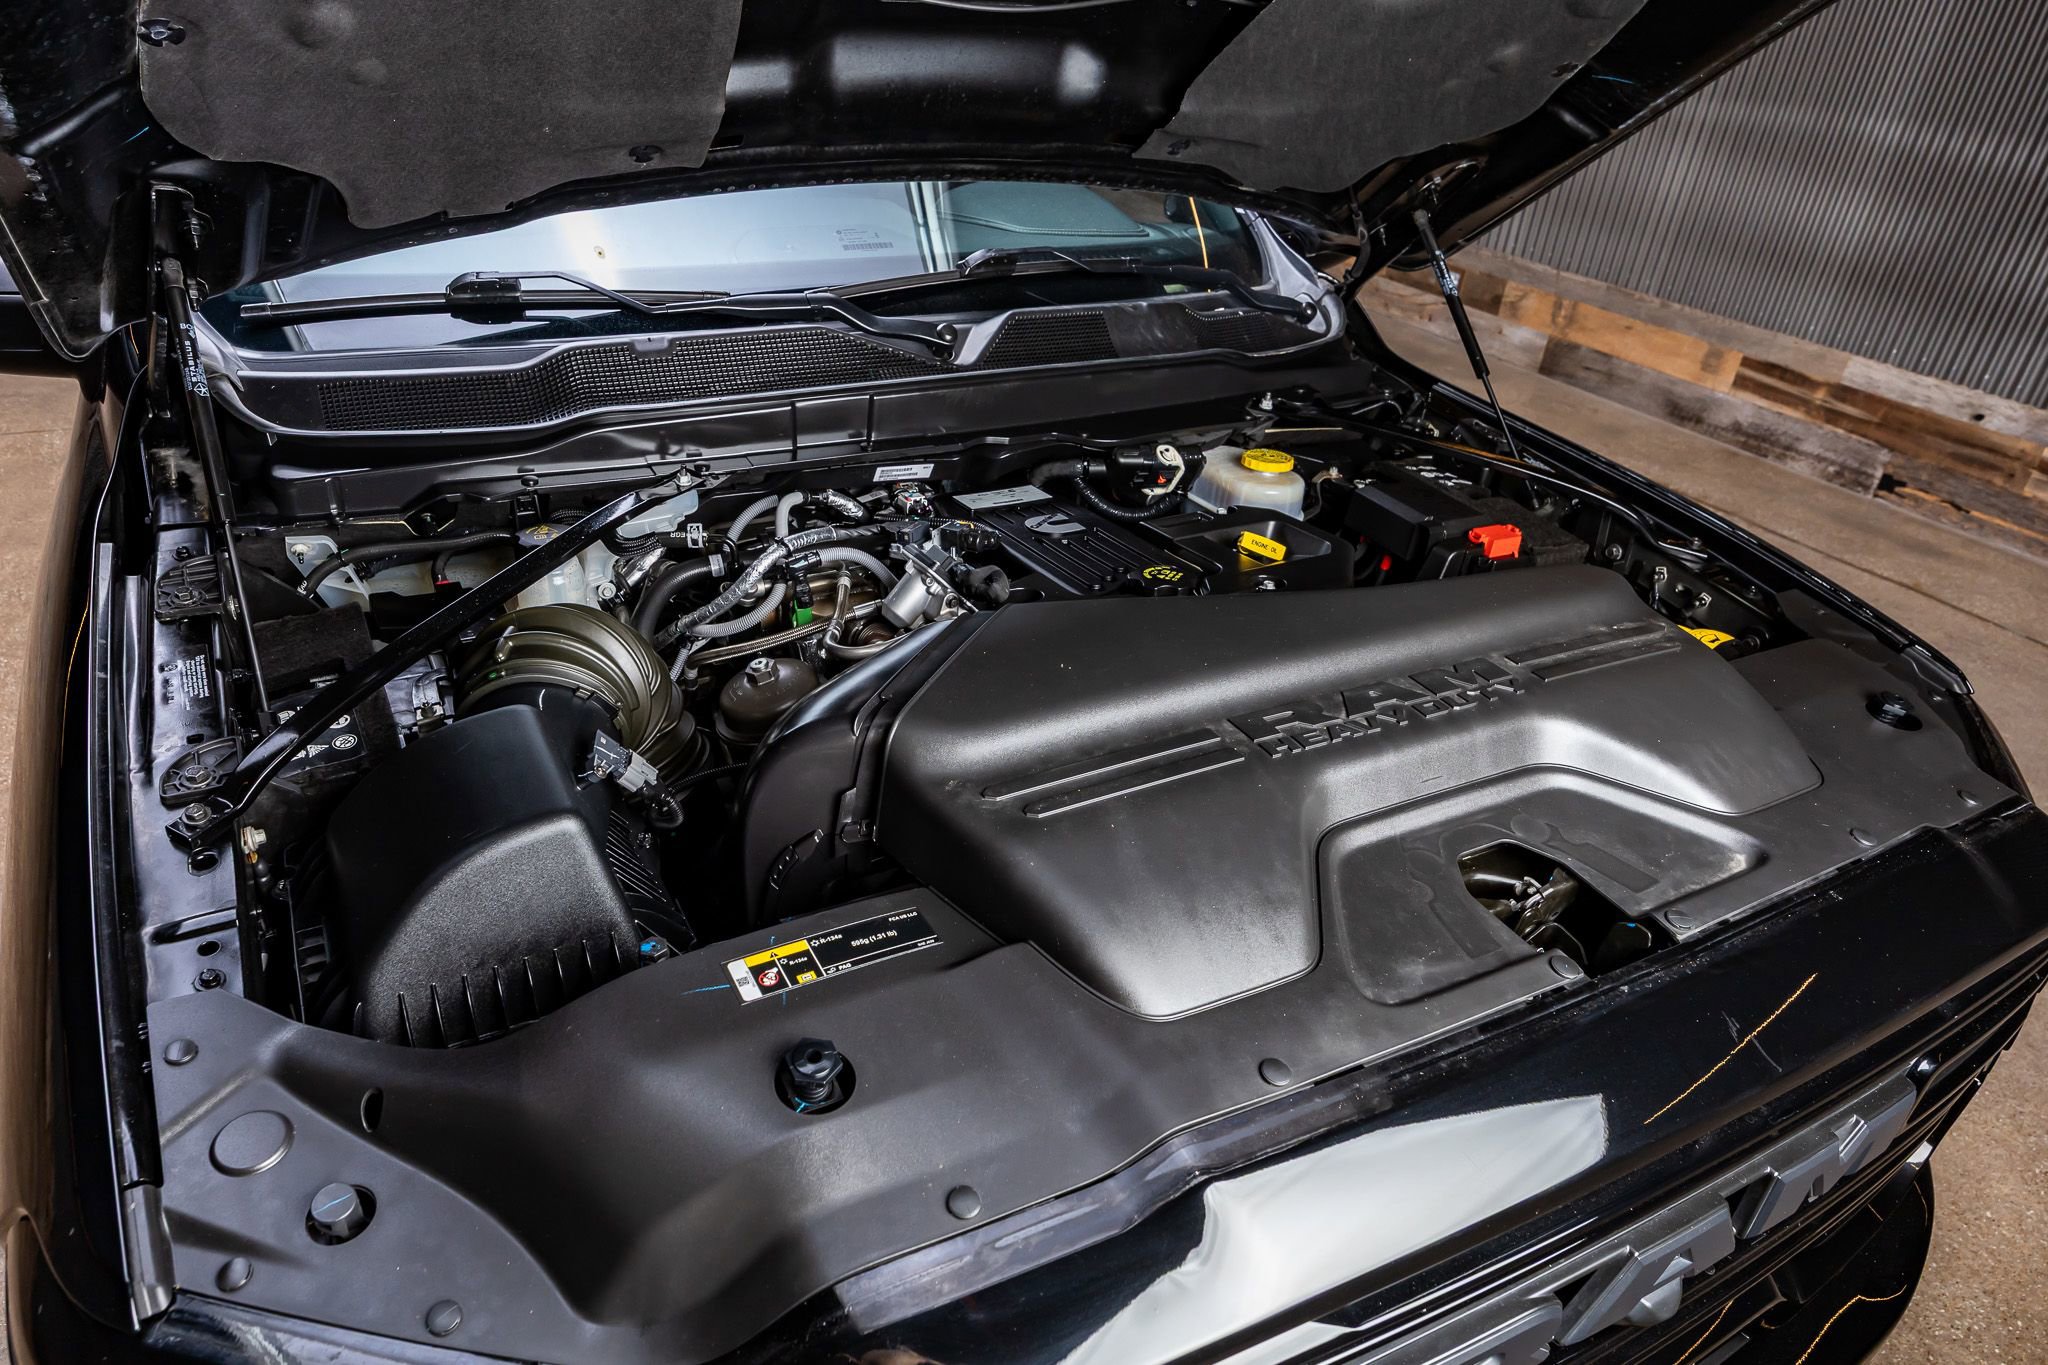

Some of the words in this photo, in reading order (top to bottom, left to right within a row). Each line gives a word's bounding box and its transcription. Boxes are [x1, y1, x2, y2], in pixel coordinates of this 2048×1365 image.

[184, 340, 198, 382] STABILUS
[1226, 657, 1514, 742] RAM
[1257, 703, 1408, 758] HEAVY
[1411, 680, 1525, 718] DUTY
[820, 934, 843, 944] R-134a
[851, 937, 870, 947] 595g
